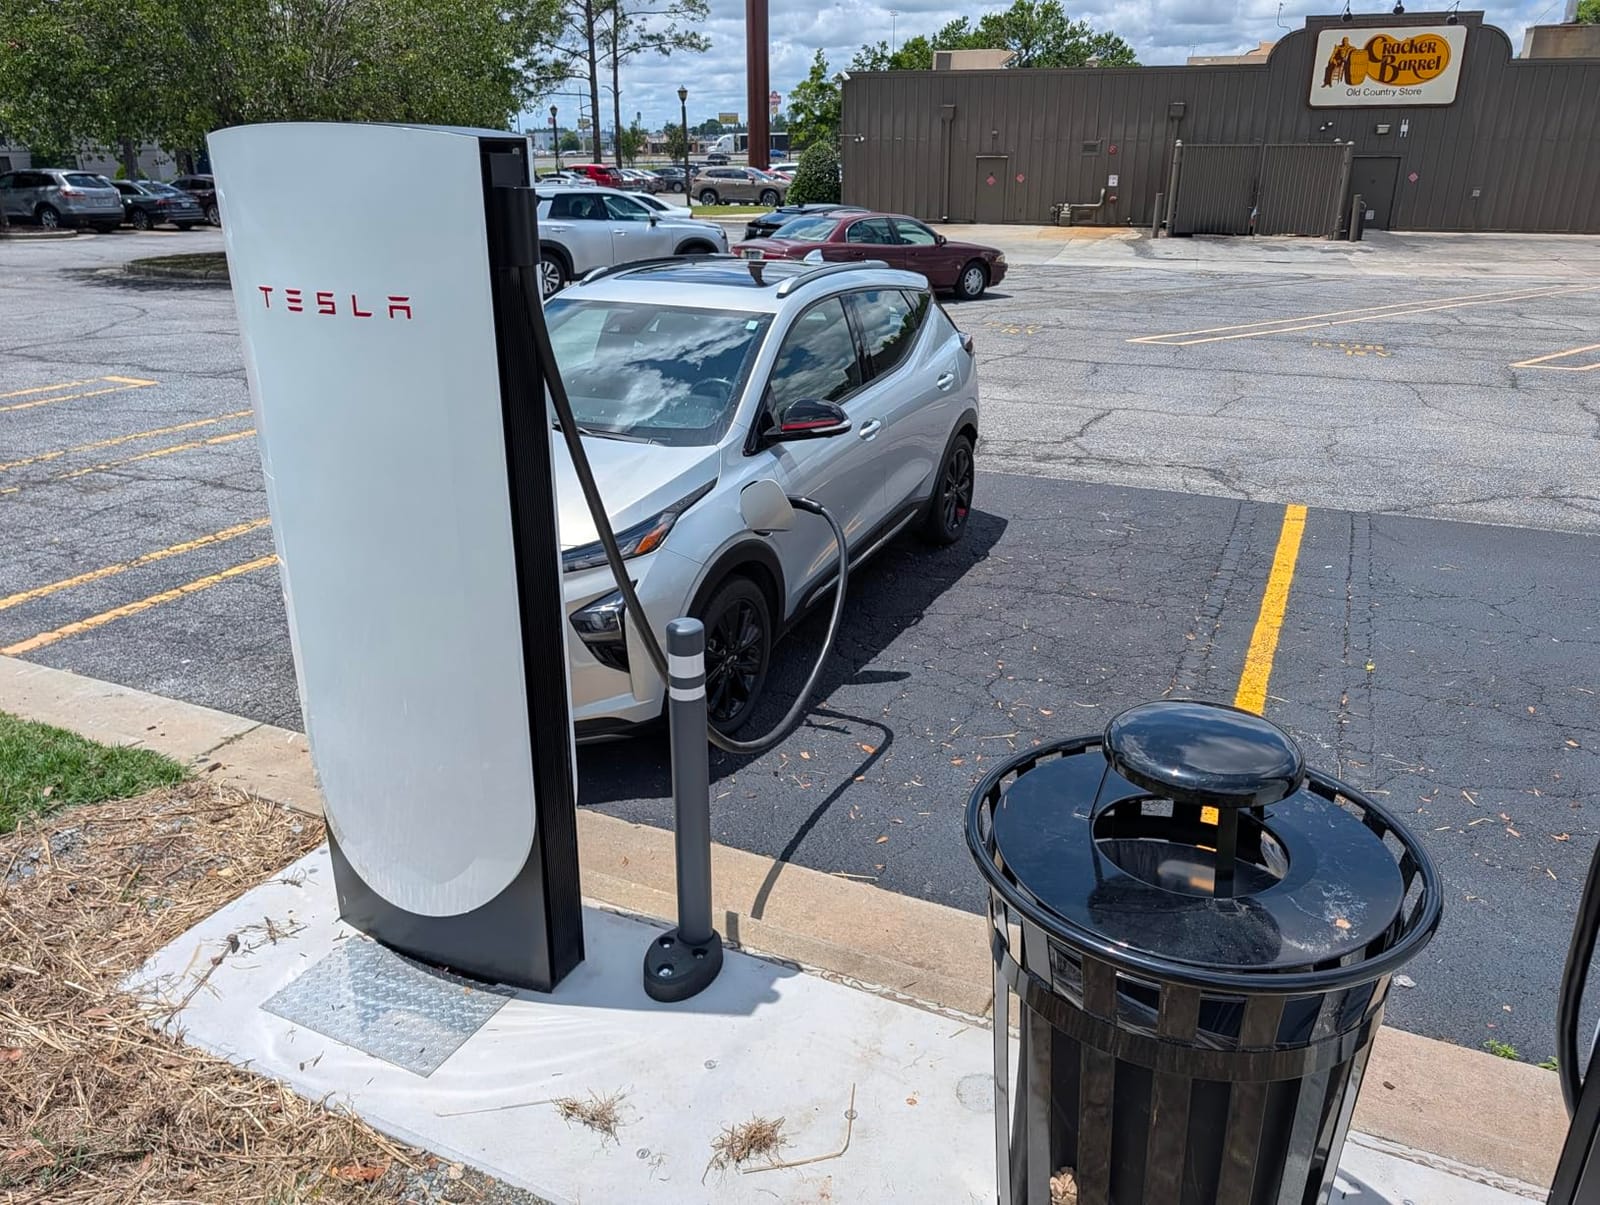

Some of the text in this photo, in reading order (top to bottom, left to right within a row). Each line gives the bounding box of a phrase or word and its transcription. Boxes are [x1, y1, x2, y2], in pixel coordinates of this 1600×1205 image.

[1365, 35, 1437, 64] Cracker
[1379, 54, 1441, 84] Barrel
[1346, 87, 1422, 97] Old Country Store
[258, 286, 412, 320] TESLA
